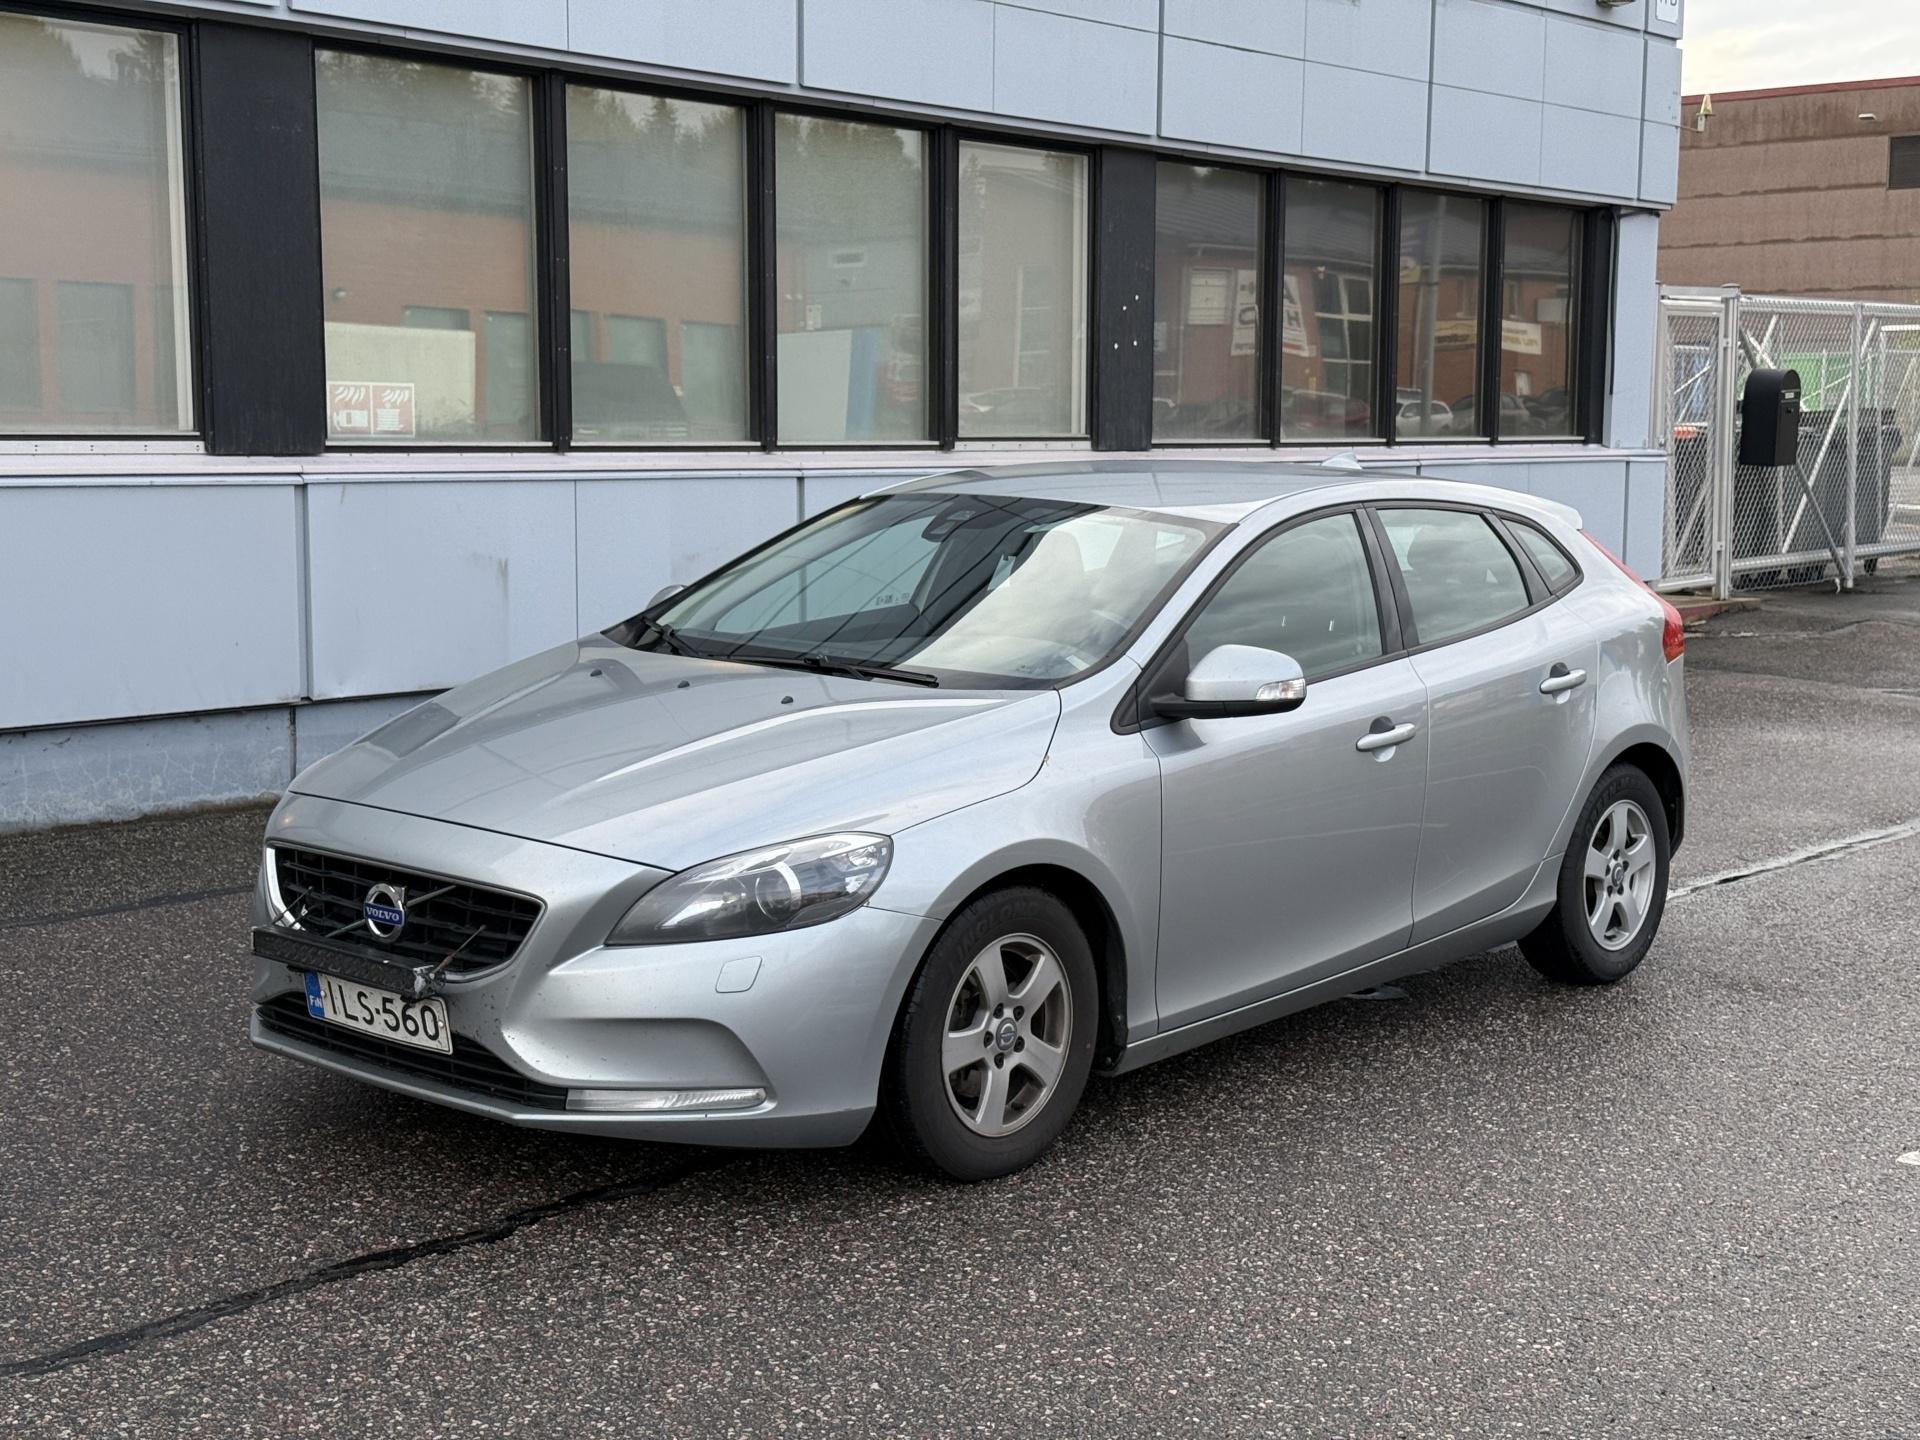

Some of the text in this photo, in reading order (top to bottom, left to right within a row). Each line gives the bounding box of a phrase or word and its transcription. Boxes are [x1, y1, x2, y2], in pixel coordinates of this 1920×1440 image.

[366, 906, 399, 921] VOLVO
[309, 995, 324, 1008] FIN
[327, 981, 440, 1040] ILS-560
